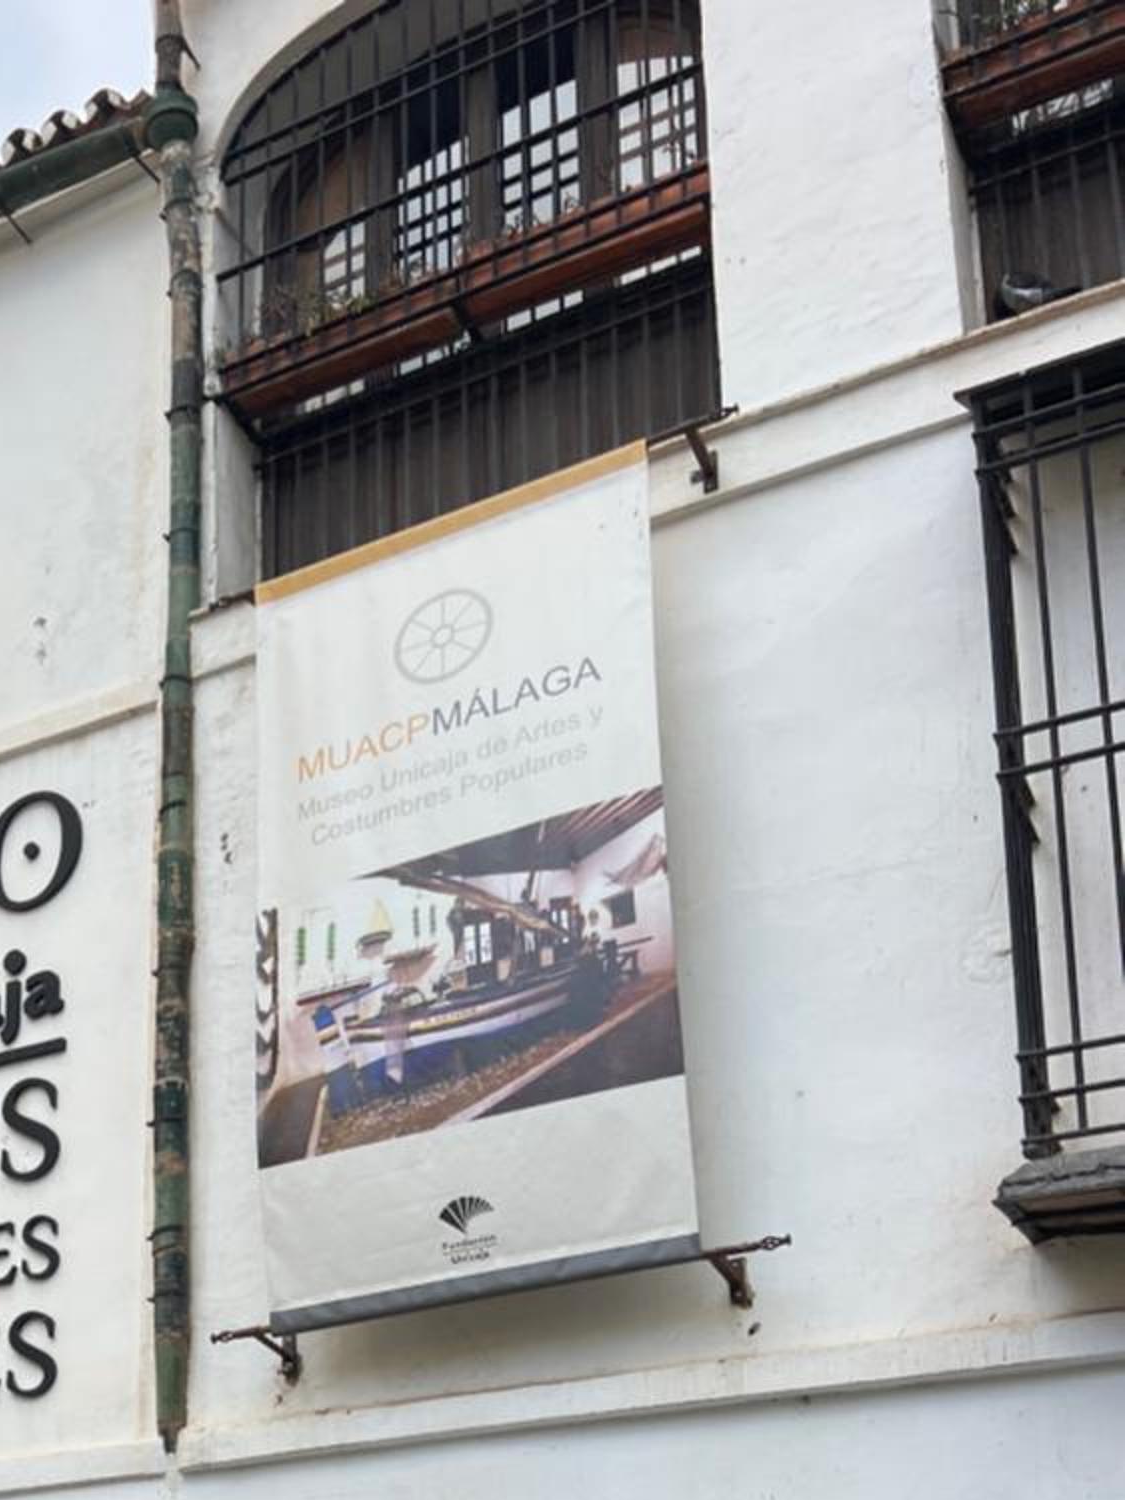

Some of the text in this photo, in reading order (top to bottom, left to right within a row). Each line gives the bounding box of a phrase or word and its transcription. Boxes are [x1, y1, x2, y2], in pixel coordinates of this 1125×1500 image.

[297, 656, 602, 784] MUACPMÁLAGA
[297, 704, 604, 822] Museo Unicaja de Artes y
[310, 741, 588, 846] Costumbres Populares
